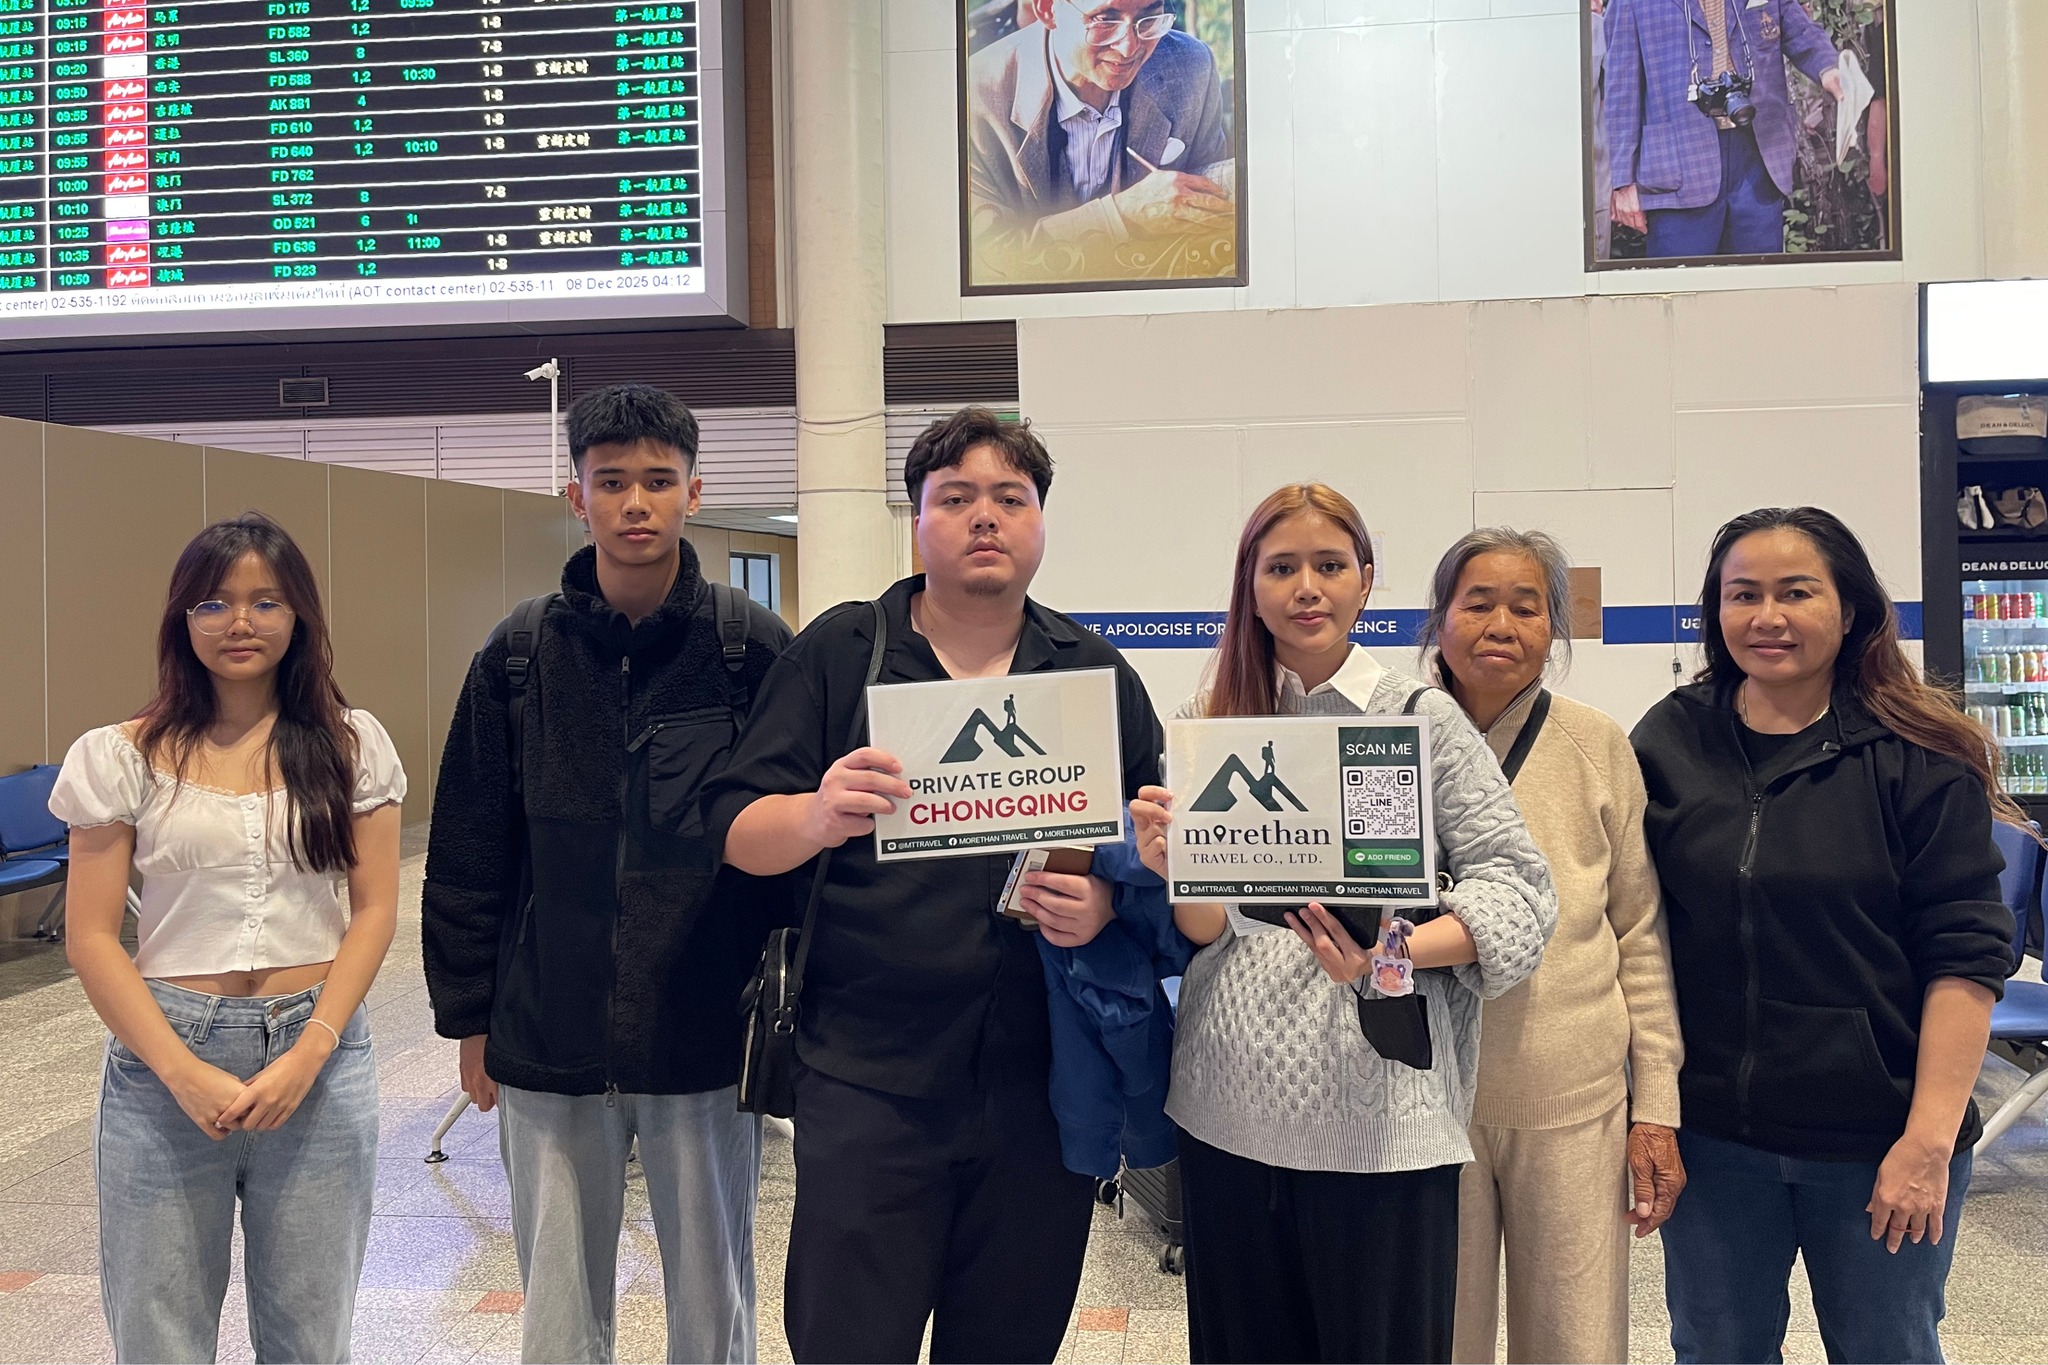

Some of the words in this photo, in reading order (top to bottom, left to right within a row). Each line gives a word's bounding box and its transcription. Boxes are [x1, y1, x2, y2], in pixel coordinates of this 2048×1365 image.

[268, 3, 285, 15] FD
[289, 2, 310, 14] 175
[351, 0, 369, 12] 1,2
[56, 17, 87, 30] 09:15
[269, 27, 286, 39] FD
[289, 26, 310, 38] 582
[352, 23, 370, 36] 1,2
[56, 40, 87, 53] 09:15
[269, 51, 286, 63] SL
[286, 50, 309, 62] 360
[356, 47, 365, 59] 8
[56, 64, 87, 76] 09:20
[269, 75, 287, 87] FD
[289, 74, 311, 86] 588
[352, 71, 371, 84] 1,2
[403, 68, 436, 80] 10:30
[56, 87, 87, 99] 09:50
[269, 99, 287, 110] AK
[289, 98, 310, 110] 881
[357, 95, 366, 106] 4
[56, 110, 87, 122] 09:55
[270, 122, 288, 134] FD
[289, 121, 312, 133] 610
[354, 119, 372, 132] 1,2
[56, 133, 88, 146] 09:55
[271, 146, 289, 158] FD
[290, 145, 313, 157] 640
[354, 143, 373, 156] 1,2
[405, 140, 438, 153] 10:10
[56, 157, 88, 169] 09:55
[272, 170, 290, 182] FD
[290, 169, 314, 181] 762
[57, 180, 88, 192] 10:00
[272, 194, 290, 206] SL
[290, 193, 313, 205] 372
[360, 191, 369, 202] 8
[57, 203, 88, 215] 10:10
[273, 218, 291, 230] OD
[294, 217, 315, 229] 521
[360, 215, 370, 226] 6
[58, 227, 89, 239] 10:25
[273, 242, 291, 253] FD
[293, 241, 316, 253] 636
[357, 239, 376, 252] 1,2
[407, 237, 440, 249] 11:00
[58, 250, 89, 262] 10:35
[274, 265, 292, 277] FD
[294, 265, 316, 277] 323
[357, 263, 376, 276] 1,2
[59, 274, 90, 286] 10:50
[566, 279, 582, 291] 08
[587, 277, 612, 290] Dec
[617, 275, 649, 288] 2025
[653, 273, 691, 287] 04:12
[350, 286, 381, 299] (AOT
[386, 284, 436, 297] contact
[440, 282, 486, 297] center)
[51, 294, 127, 309] 02-535-1192
[1962, 562, 1998, 571] DEAN
[1105, 623, 1192, 636] APOLOGISE
[1196, 622, 1227, 636] FOR
[1346, 743, 1386, 756] SCAN
[1390, 743, 1413, 755] ME
[910, 771, 1003, 794] PRIVATE
[1007, 765, 1086, 787] GROUP
[909, 790, 1088, 825] CHONGQING
[1370, 798, 1392, 807] LINE
[898, 839, 943, 850] @MTTRAVEL
[959, 835, 1000, 845] MORETHAN
[1002, 832, 1029, 841] TRAVEL
[1044, 826, 1112, 838] MORETHAN.TRAVEL
[1190, 853, 1248, 864] TRAVEL
[1253, 853, 1284, 865] CO.,
[1289, 853, 1323, 864] LTD.
[1367, 853, 1384, 861] ADD
[1384, 853, 1412, 861] FRIEND
[1191, 885, 1238, 894] @MTTRAVEL
[1254, 885, 1299, 894] MORETHAN
[1300, 885, 1330, 894] TRAVEL
[1347, 886, 1423, 896] MORETHAN.TRAVEL
